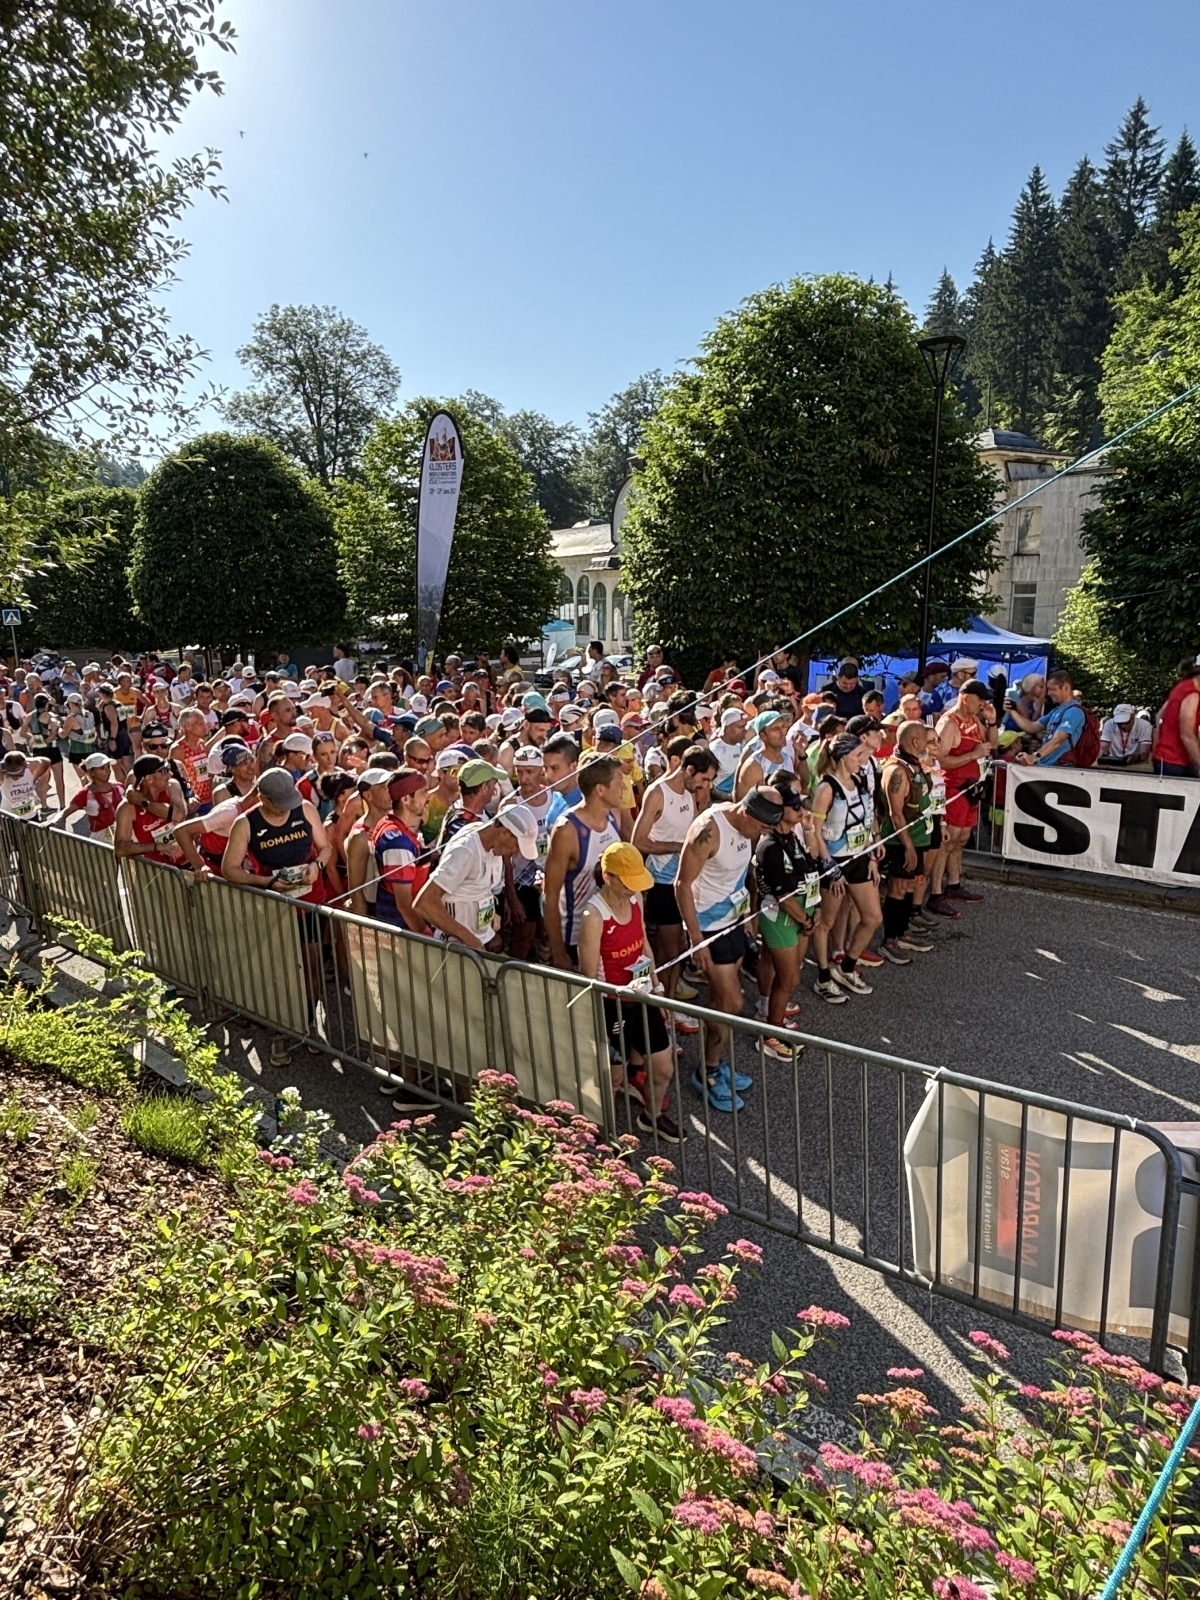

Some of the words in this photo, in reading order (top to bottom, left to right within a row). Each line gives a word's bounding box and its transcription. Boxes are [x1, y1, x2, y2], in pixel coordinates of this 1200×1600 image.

[429, 462, 457, 471] KLOSTERS
[679, 804, 690, 813] ARG
[260, 829, 308, 851] ROMANIA
[737, 841, 748, 853] ARG
